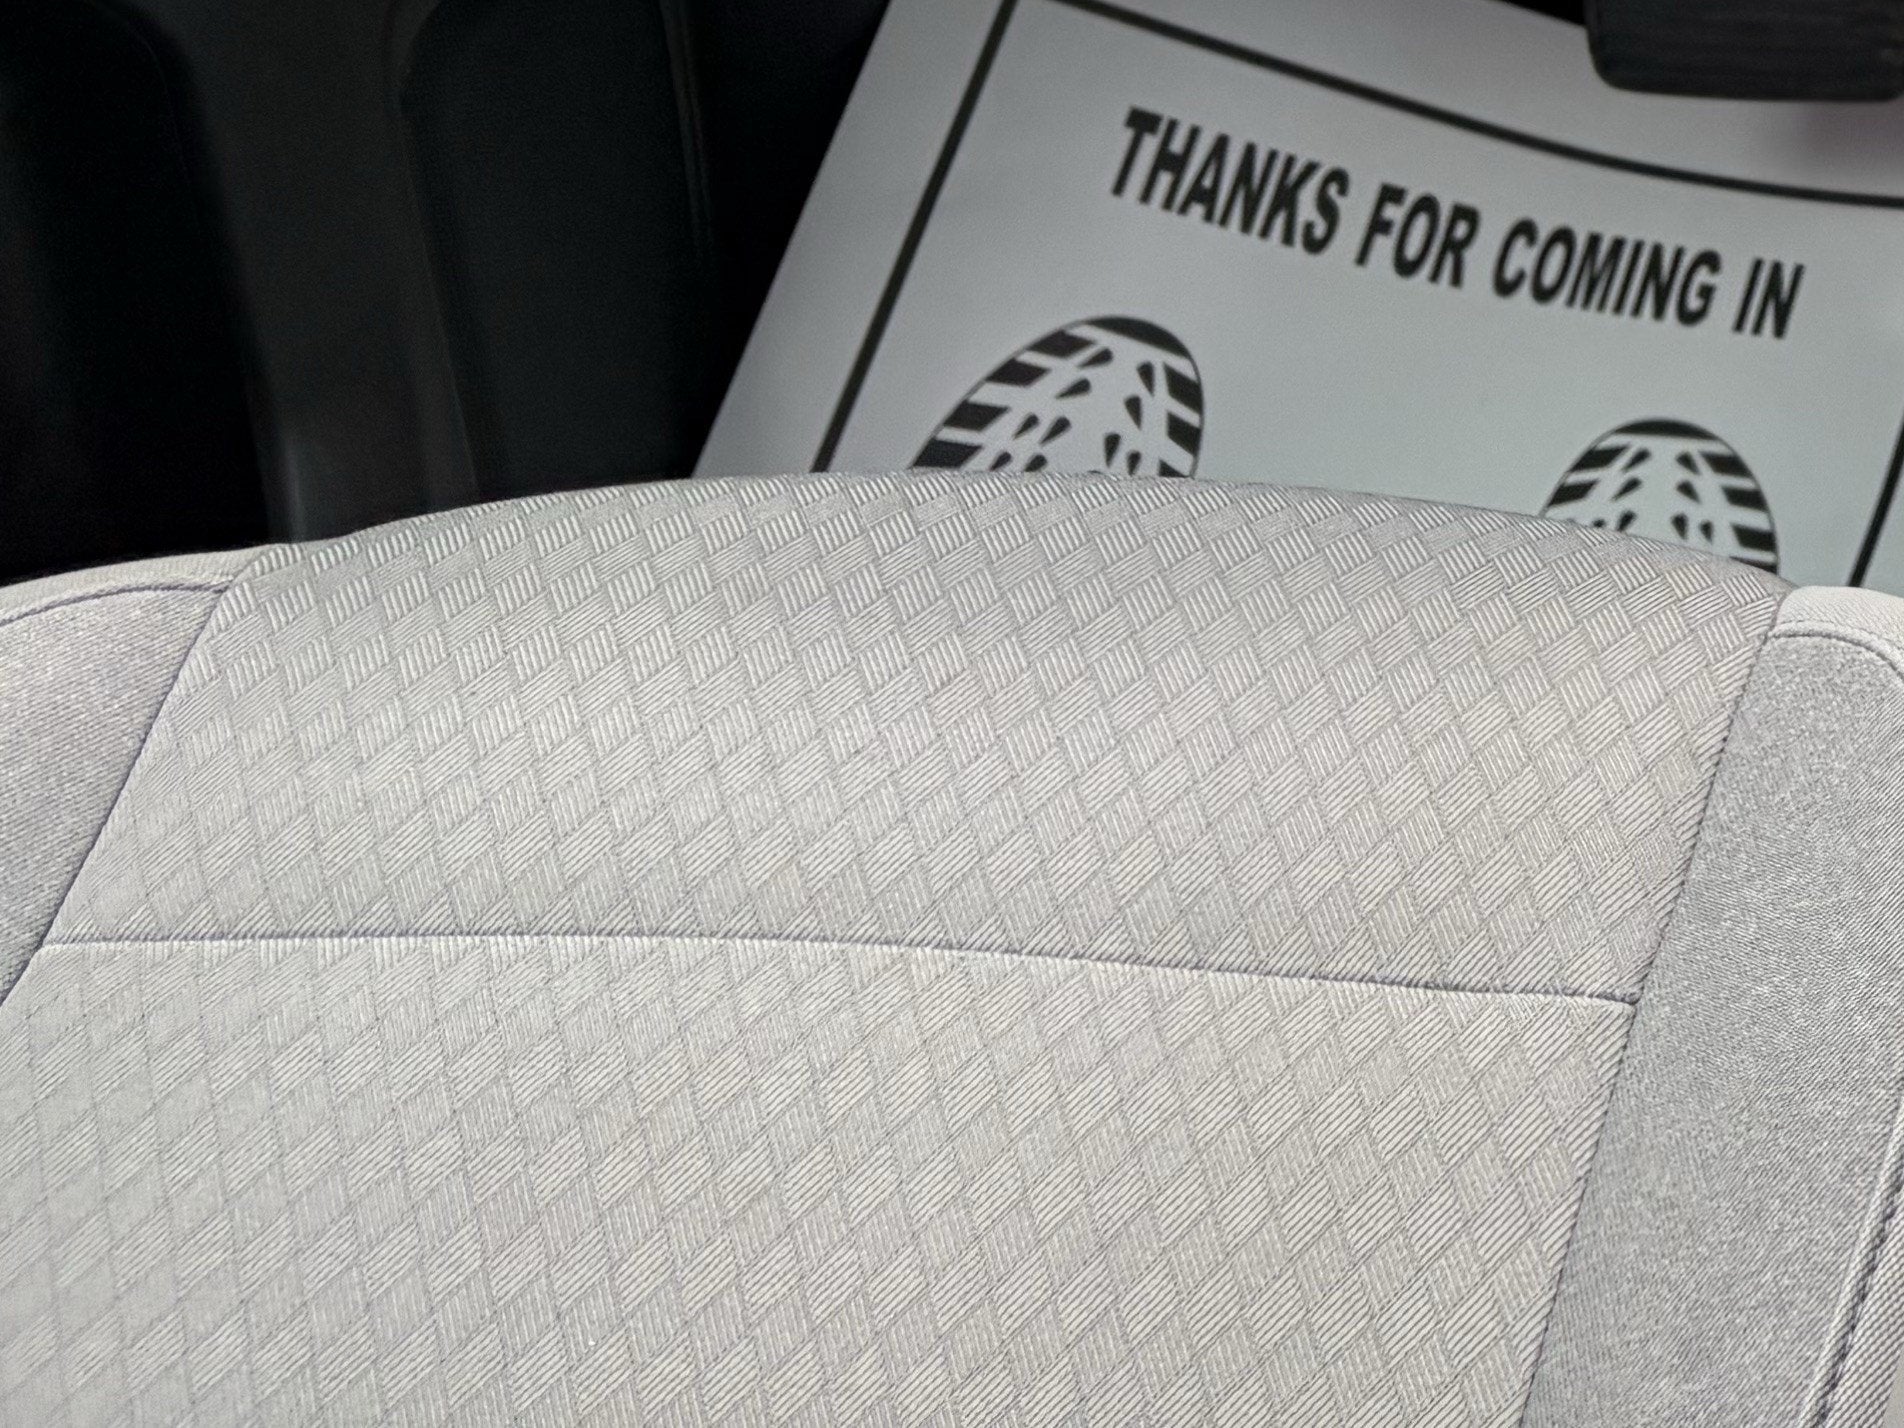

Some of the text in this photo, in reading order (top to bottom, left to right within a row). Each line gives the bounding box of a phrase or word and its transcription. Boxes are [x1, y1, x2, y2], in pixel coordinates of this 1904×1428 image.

[1109, 104, 1804, 342] THANKS FOR COMING IN
